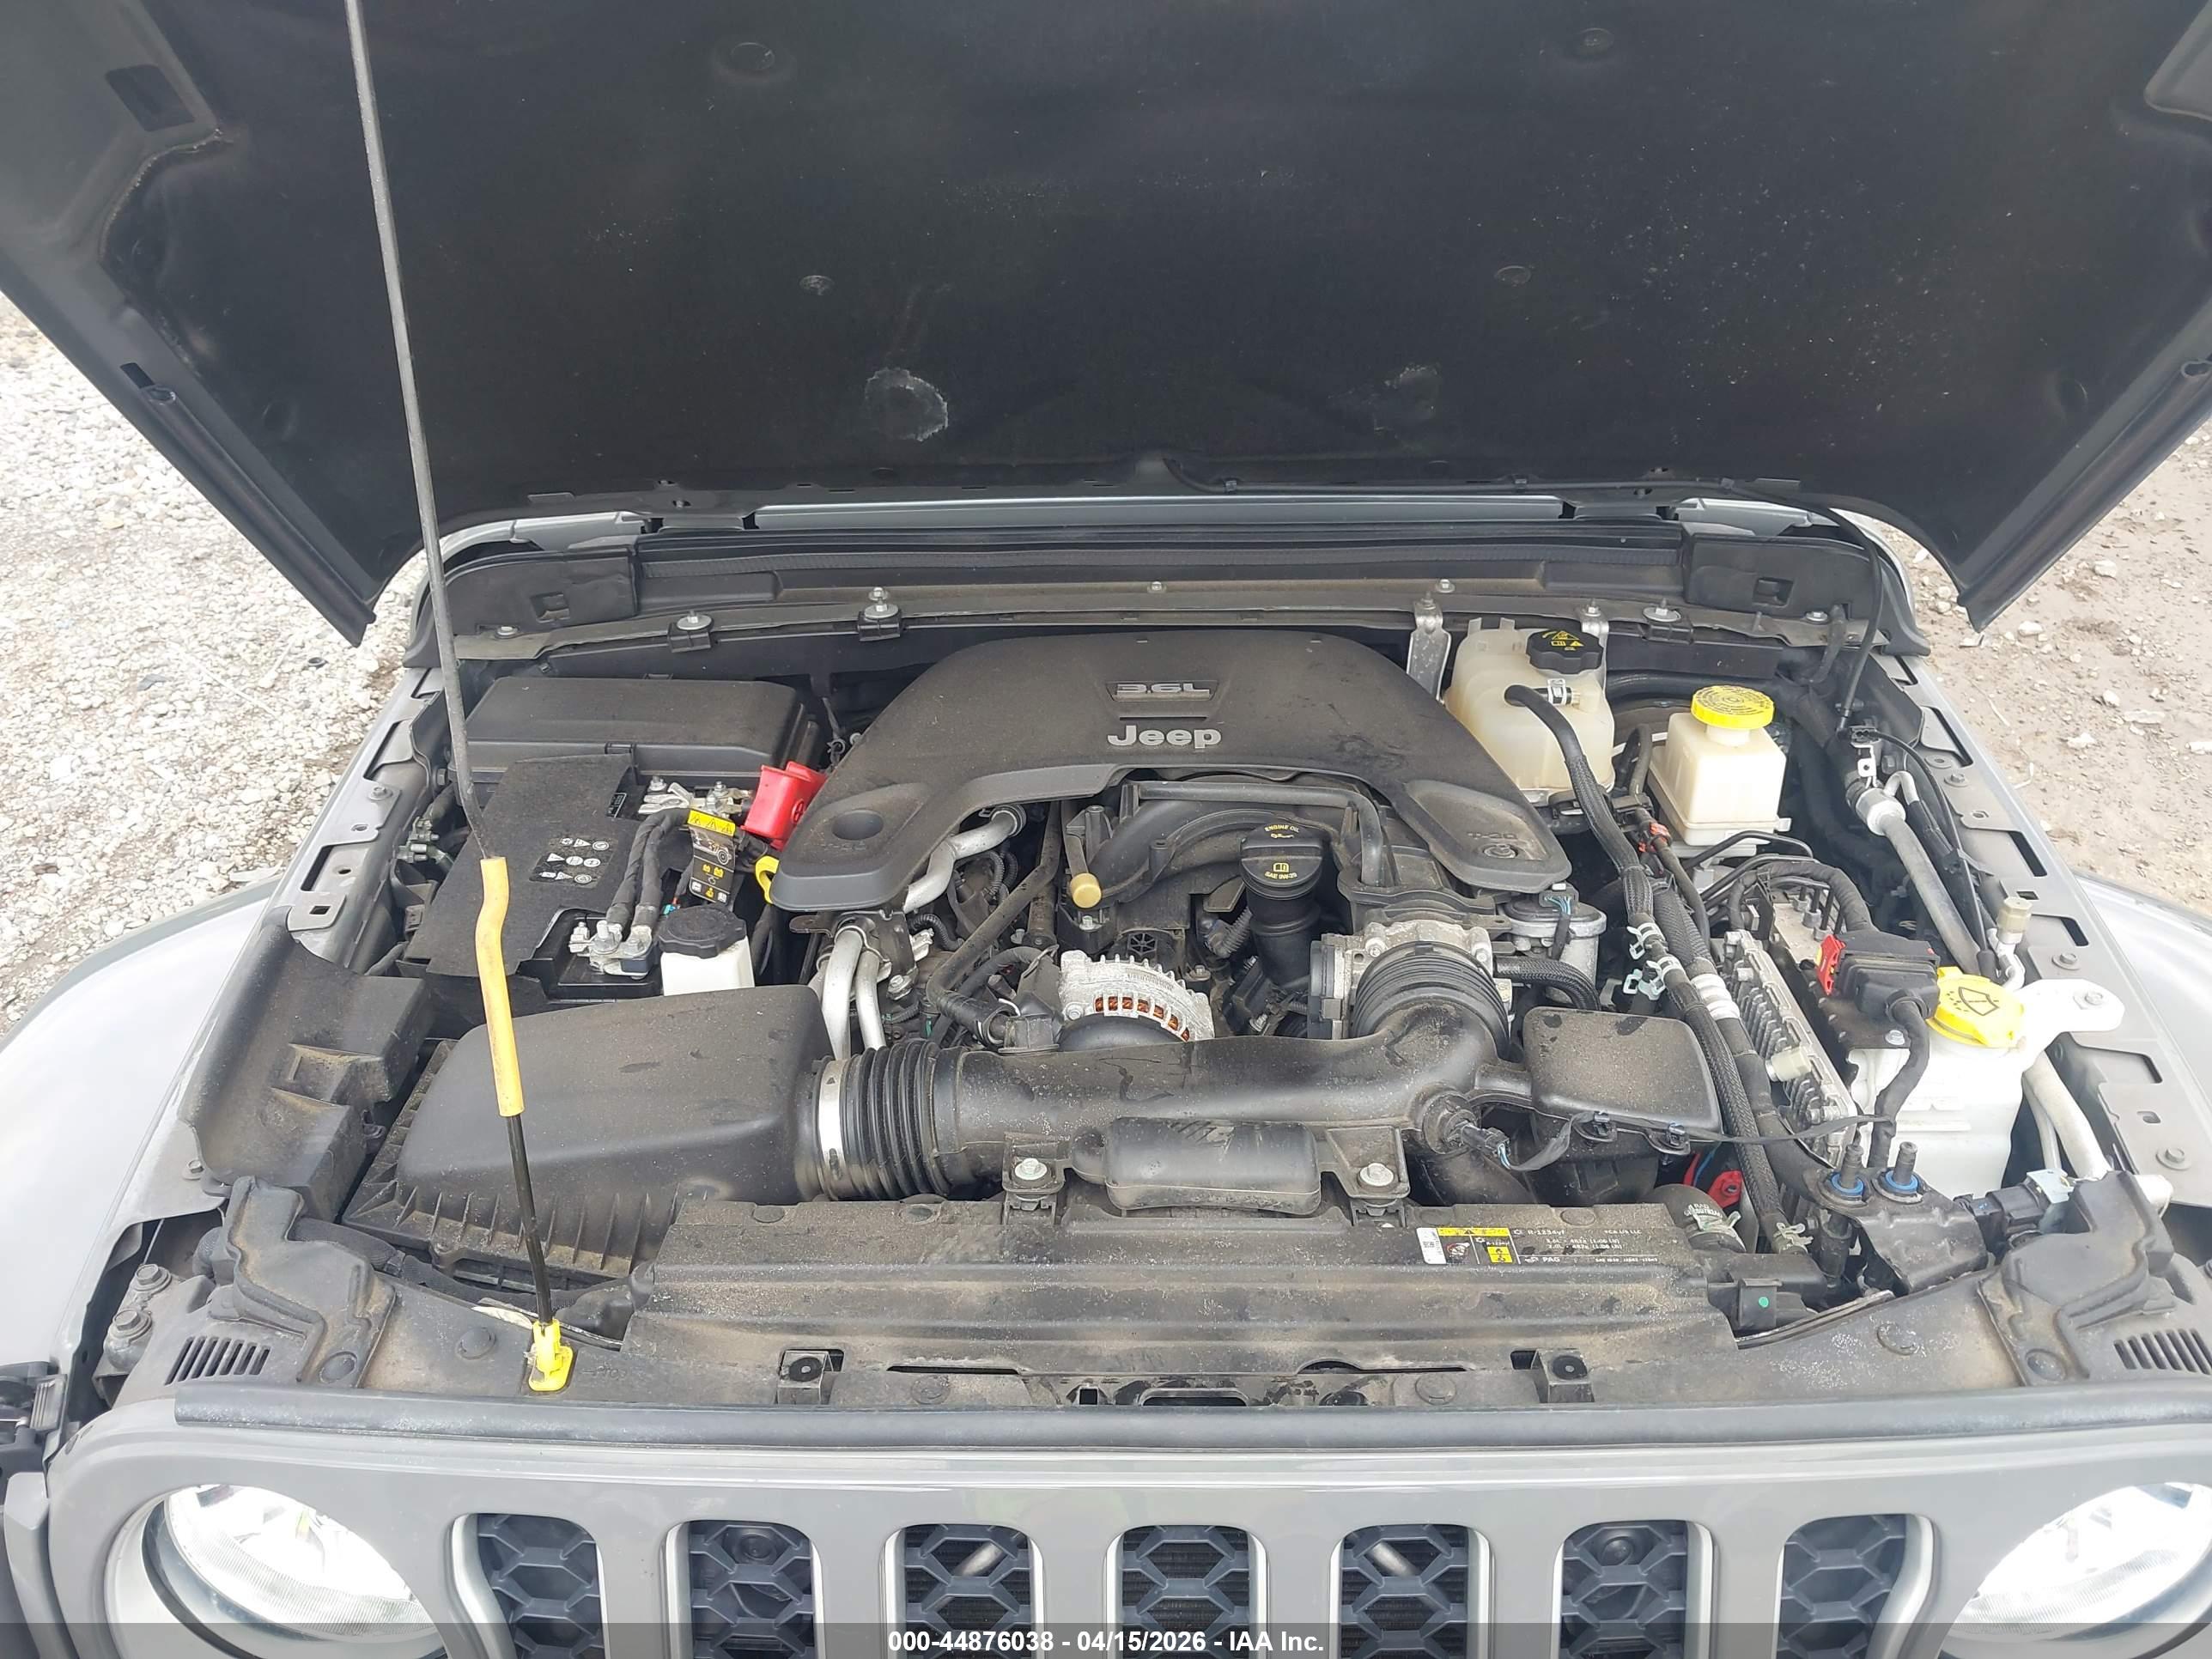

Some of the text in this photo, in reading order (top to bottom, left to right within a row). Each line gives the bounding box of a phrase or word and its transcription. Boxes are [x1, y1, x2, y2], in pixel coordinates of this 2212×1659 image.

[1117, 684, 1210, 693] 3.6L
[1107, 725, 1222, 749] Jeep
[1264, 871, 1278, 879] SAE
